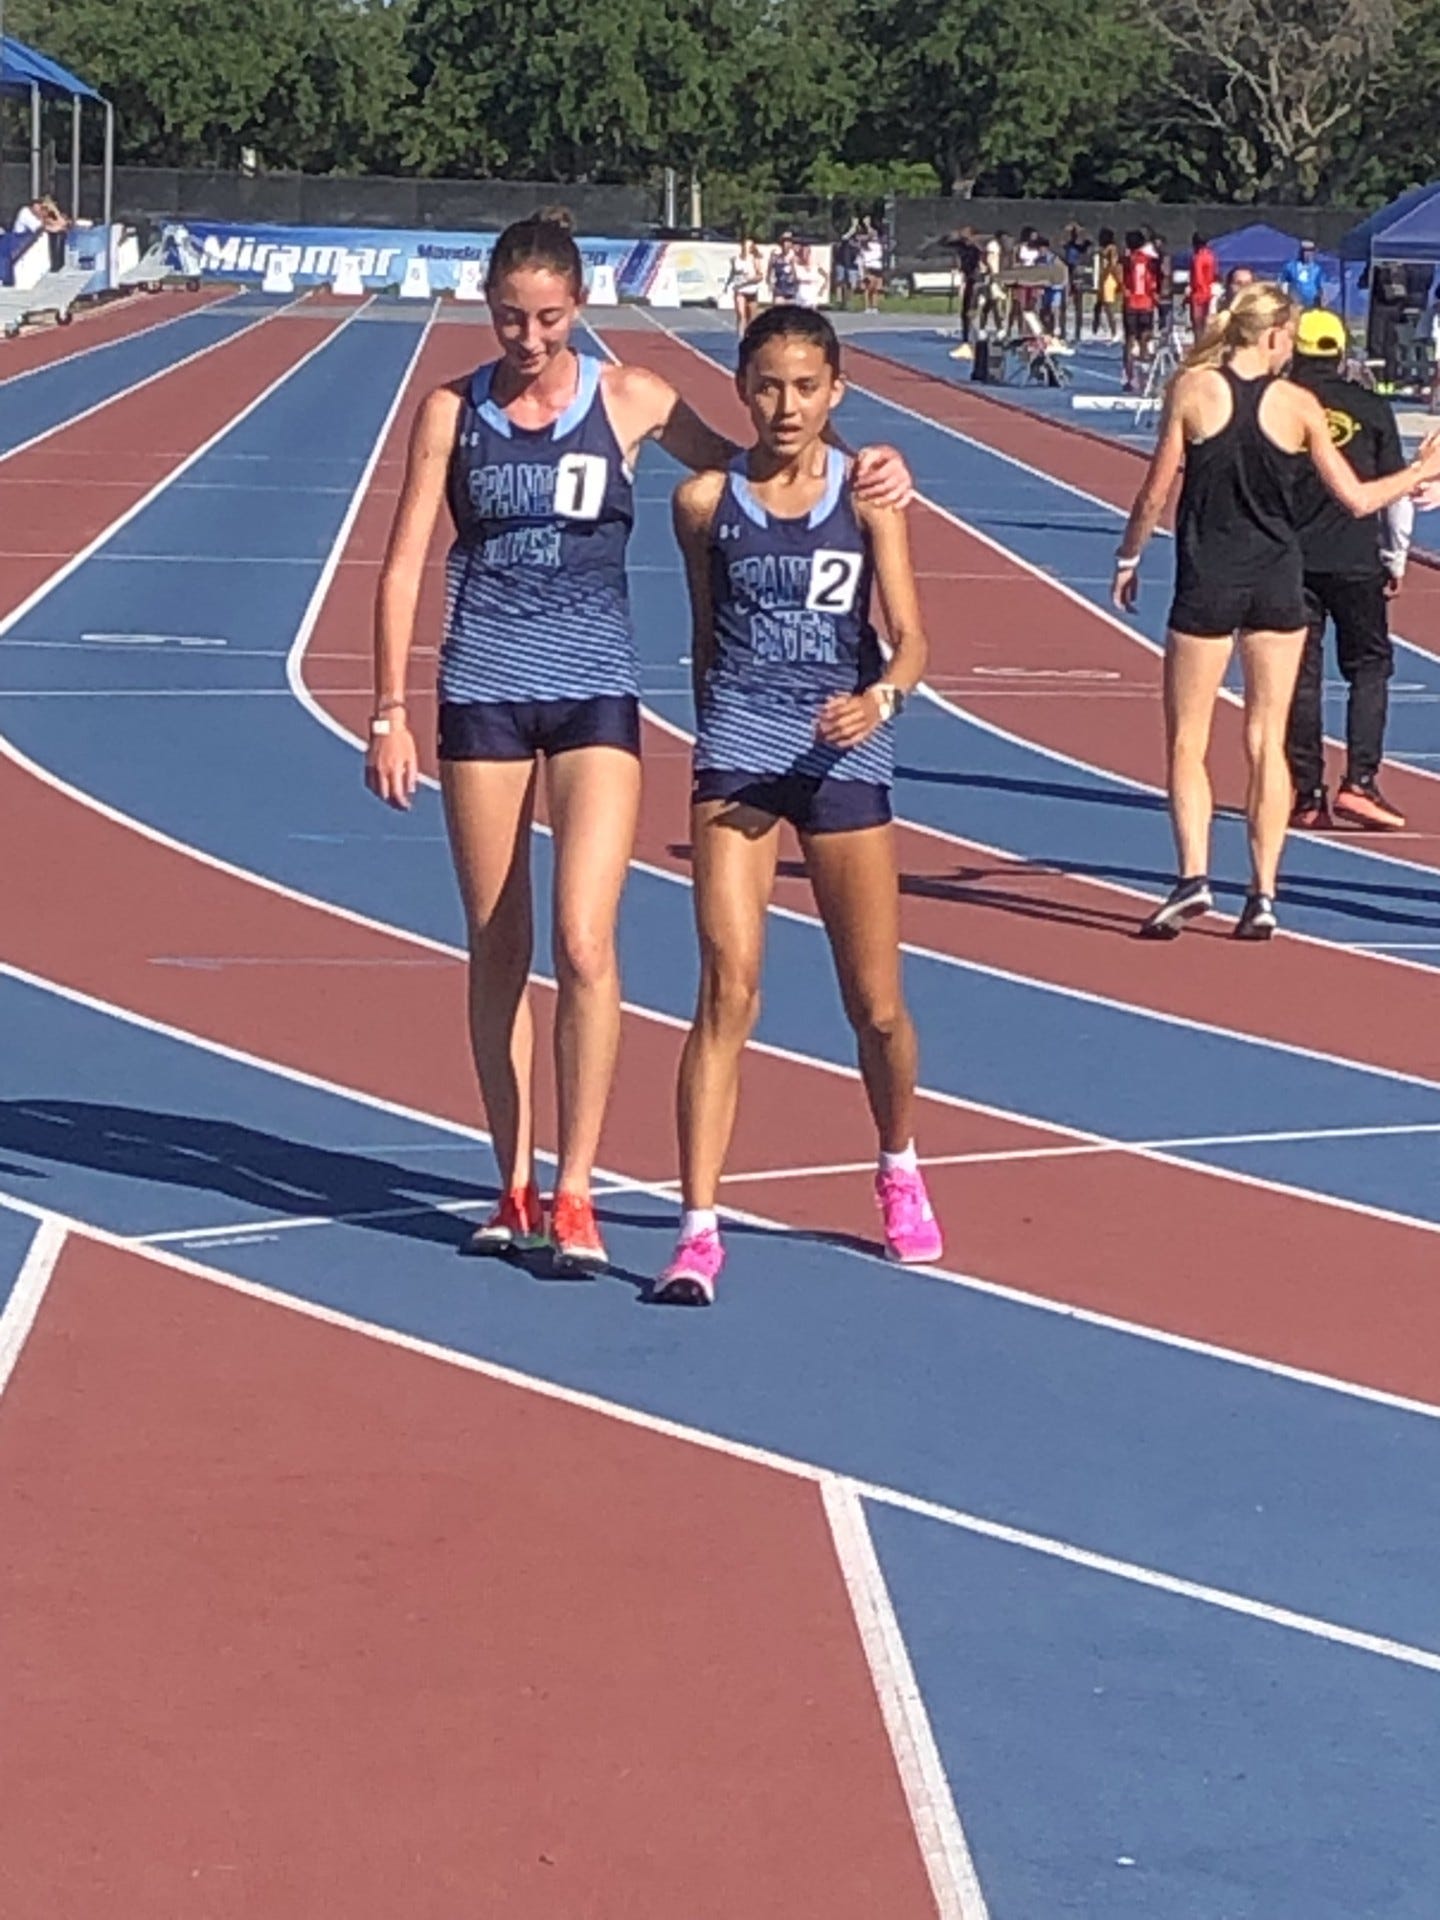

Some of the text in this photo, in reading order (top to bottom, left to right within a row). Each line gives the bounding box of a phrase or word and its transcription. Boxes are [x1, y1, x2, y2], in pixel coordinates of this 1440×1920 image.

[200, 235, 401, 276] Miramar
[567, 461, 588, 512] 1
[813, 557, 853, 607] 2
